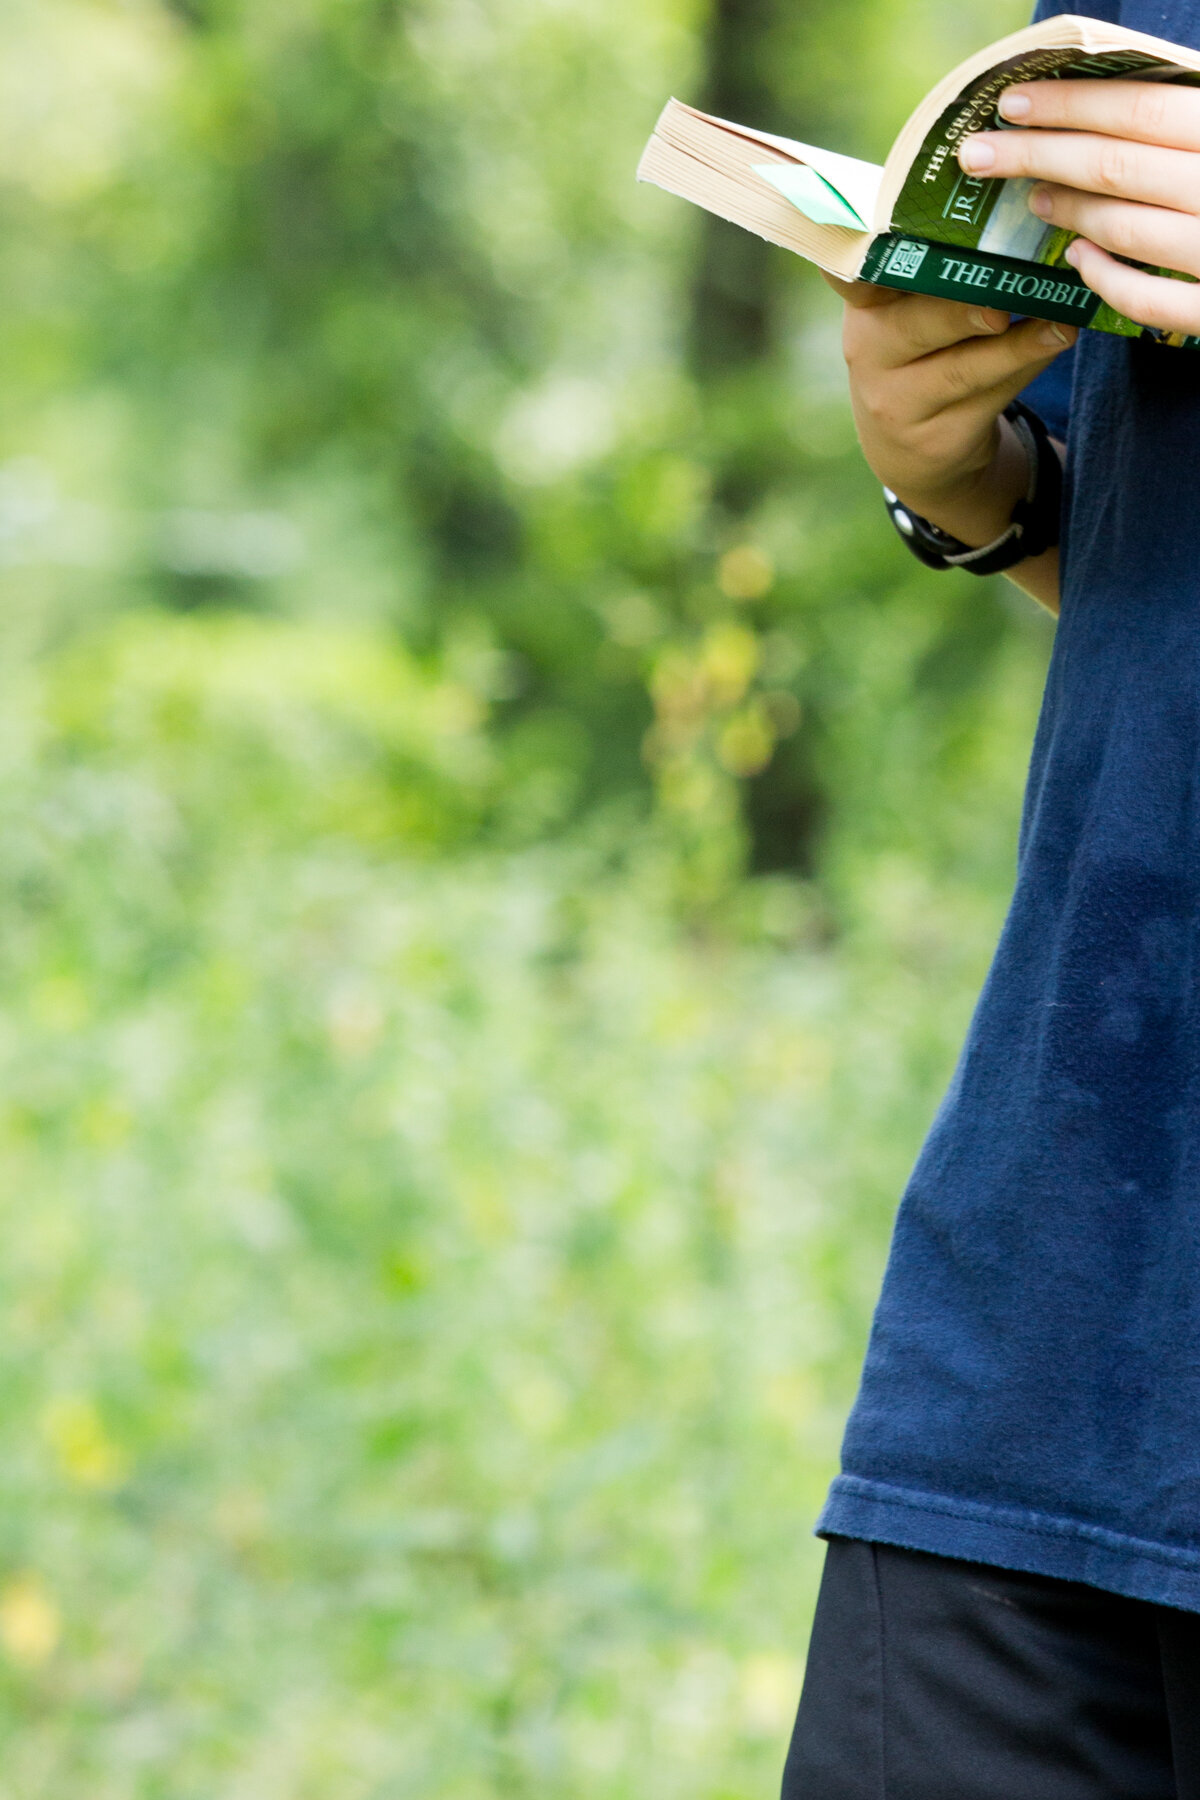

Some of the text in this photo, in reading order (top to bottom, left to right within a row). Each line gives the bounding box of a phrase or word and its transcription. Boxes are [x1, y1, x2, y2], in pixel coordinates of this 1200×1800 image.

[921, 144, 950, 184] THE
[944, 72, 1014, 140] GREATEST
[890, 242, 914, 272] DEL
[902, 243, 924, 275] REY
[938, 257, 1093, 310] THE HOBBIT
